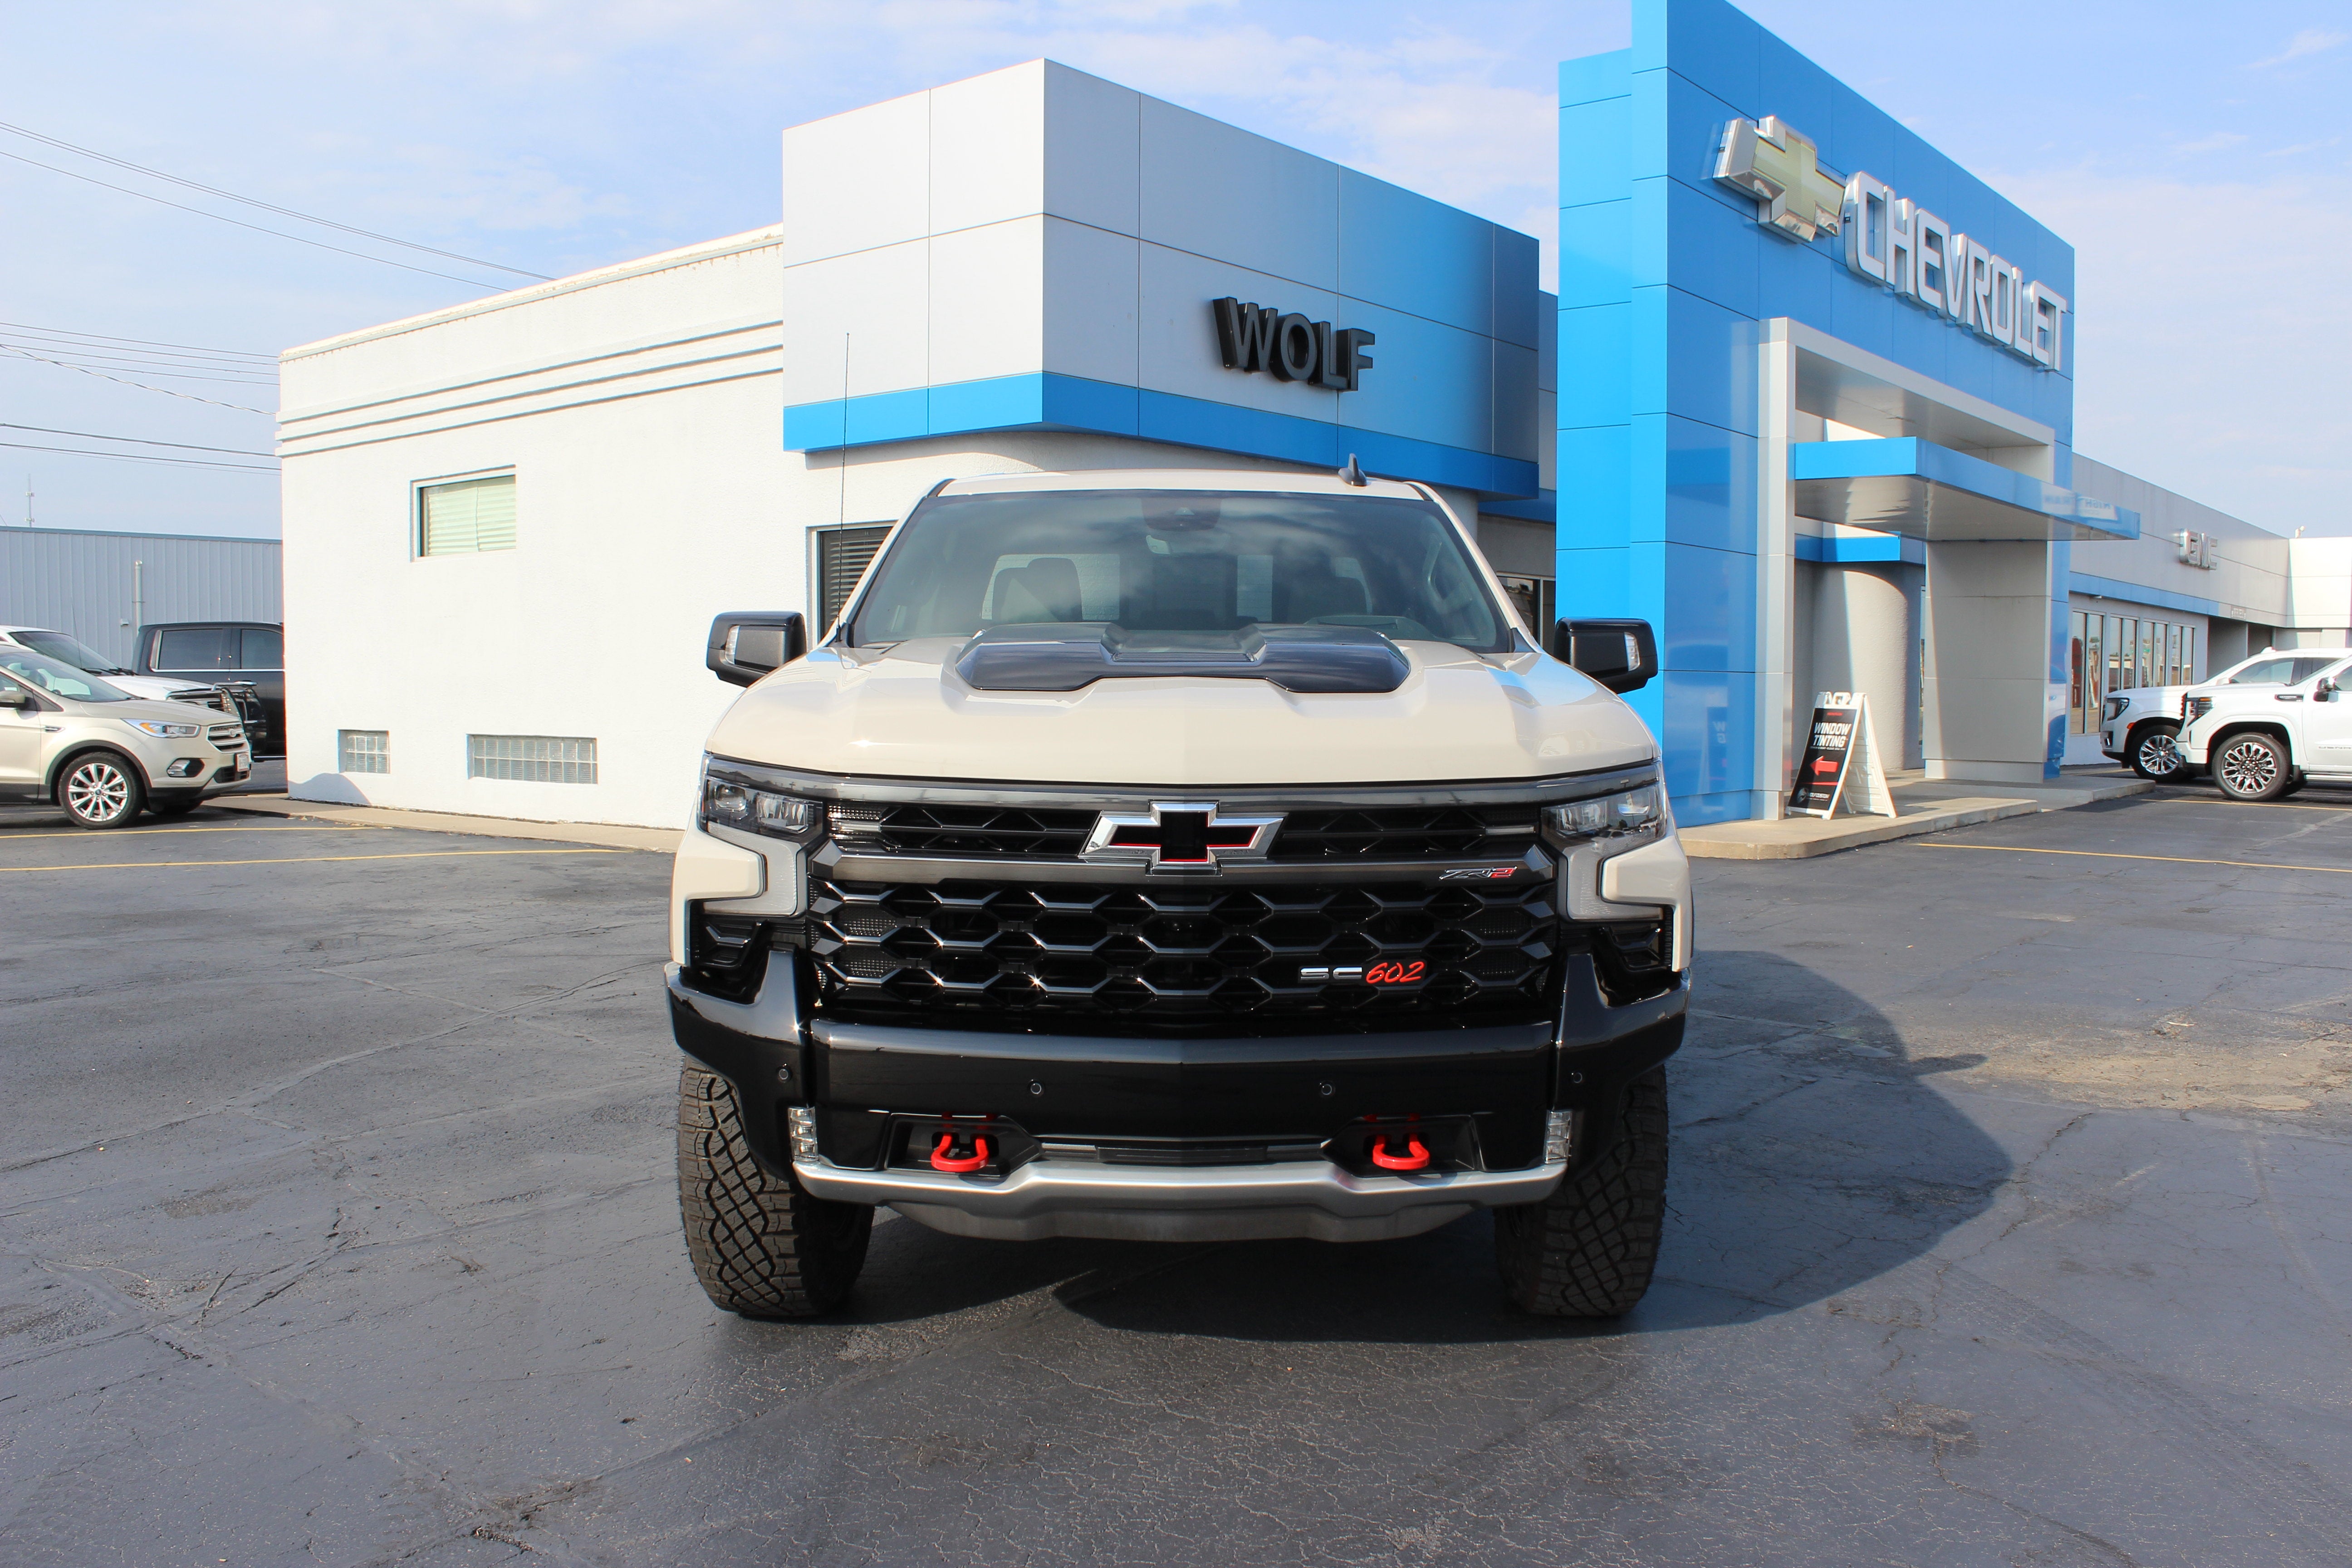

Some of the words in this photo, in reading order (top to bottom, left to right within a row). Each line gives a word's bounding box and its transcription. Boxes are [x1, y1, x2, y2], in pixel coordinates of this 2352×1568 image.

[1845, 171, 2067, 371] CHEVROLET
[1213, 296, 1375, 392] WOLF
[2179, 529, 2218, 570] GMC
[1814, 722, 1852, 735] WINDOW
[1813, 734, 1847, 748] TINTING
[1439, 866, 1518, 880] ZR2
[1366, 961, 1425, 984] 602
